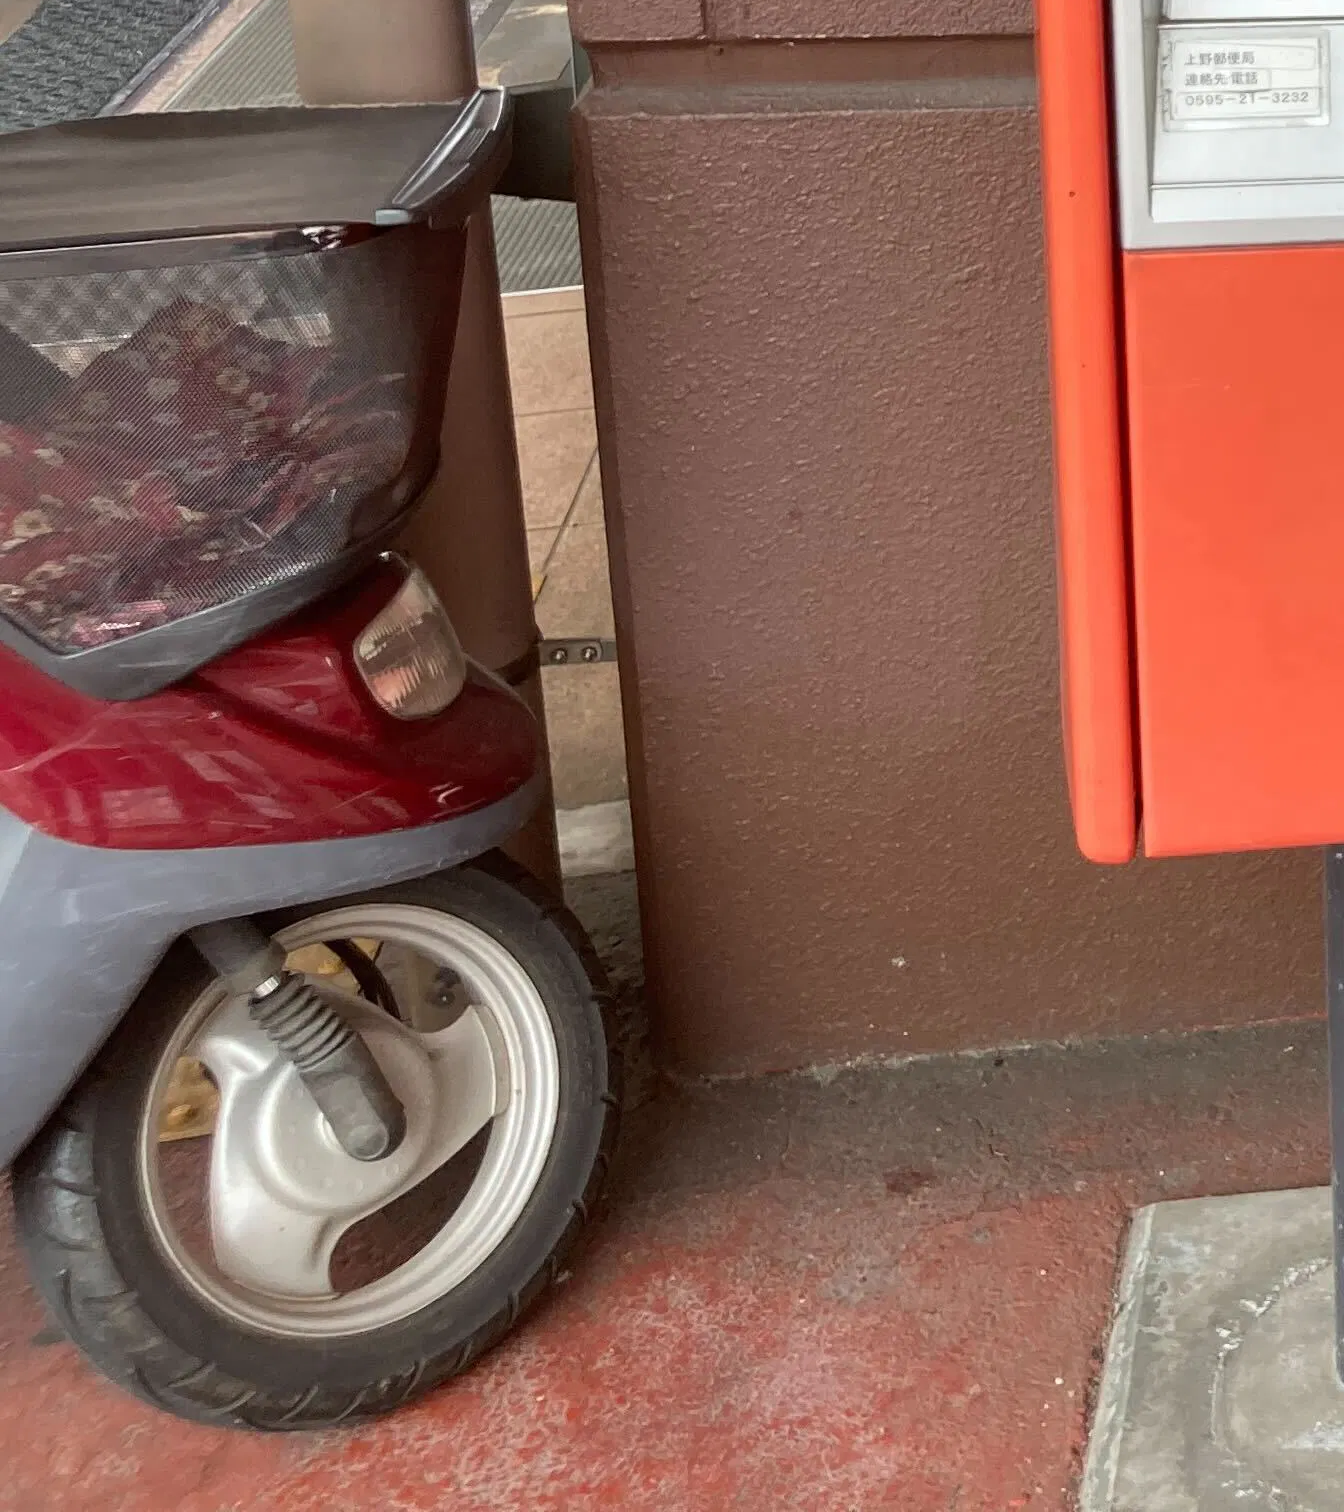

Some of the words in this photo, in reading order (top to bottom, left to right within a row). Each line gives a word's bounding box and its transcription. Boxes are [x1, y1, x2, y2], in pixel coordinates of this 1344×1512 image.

[1184, 51, 1256, 66] 上野郵便局
